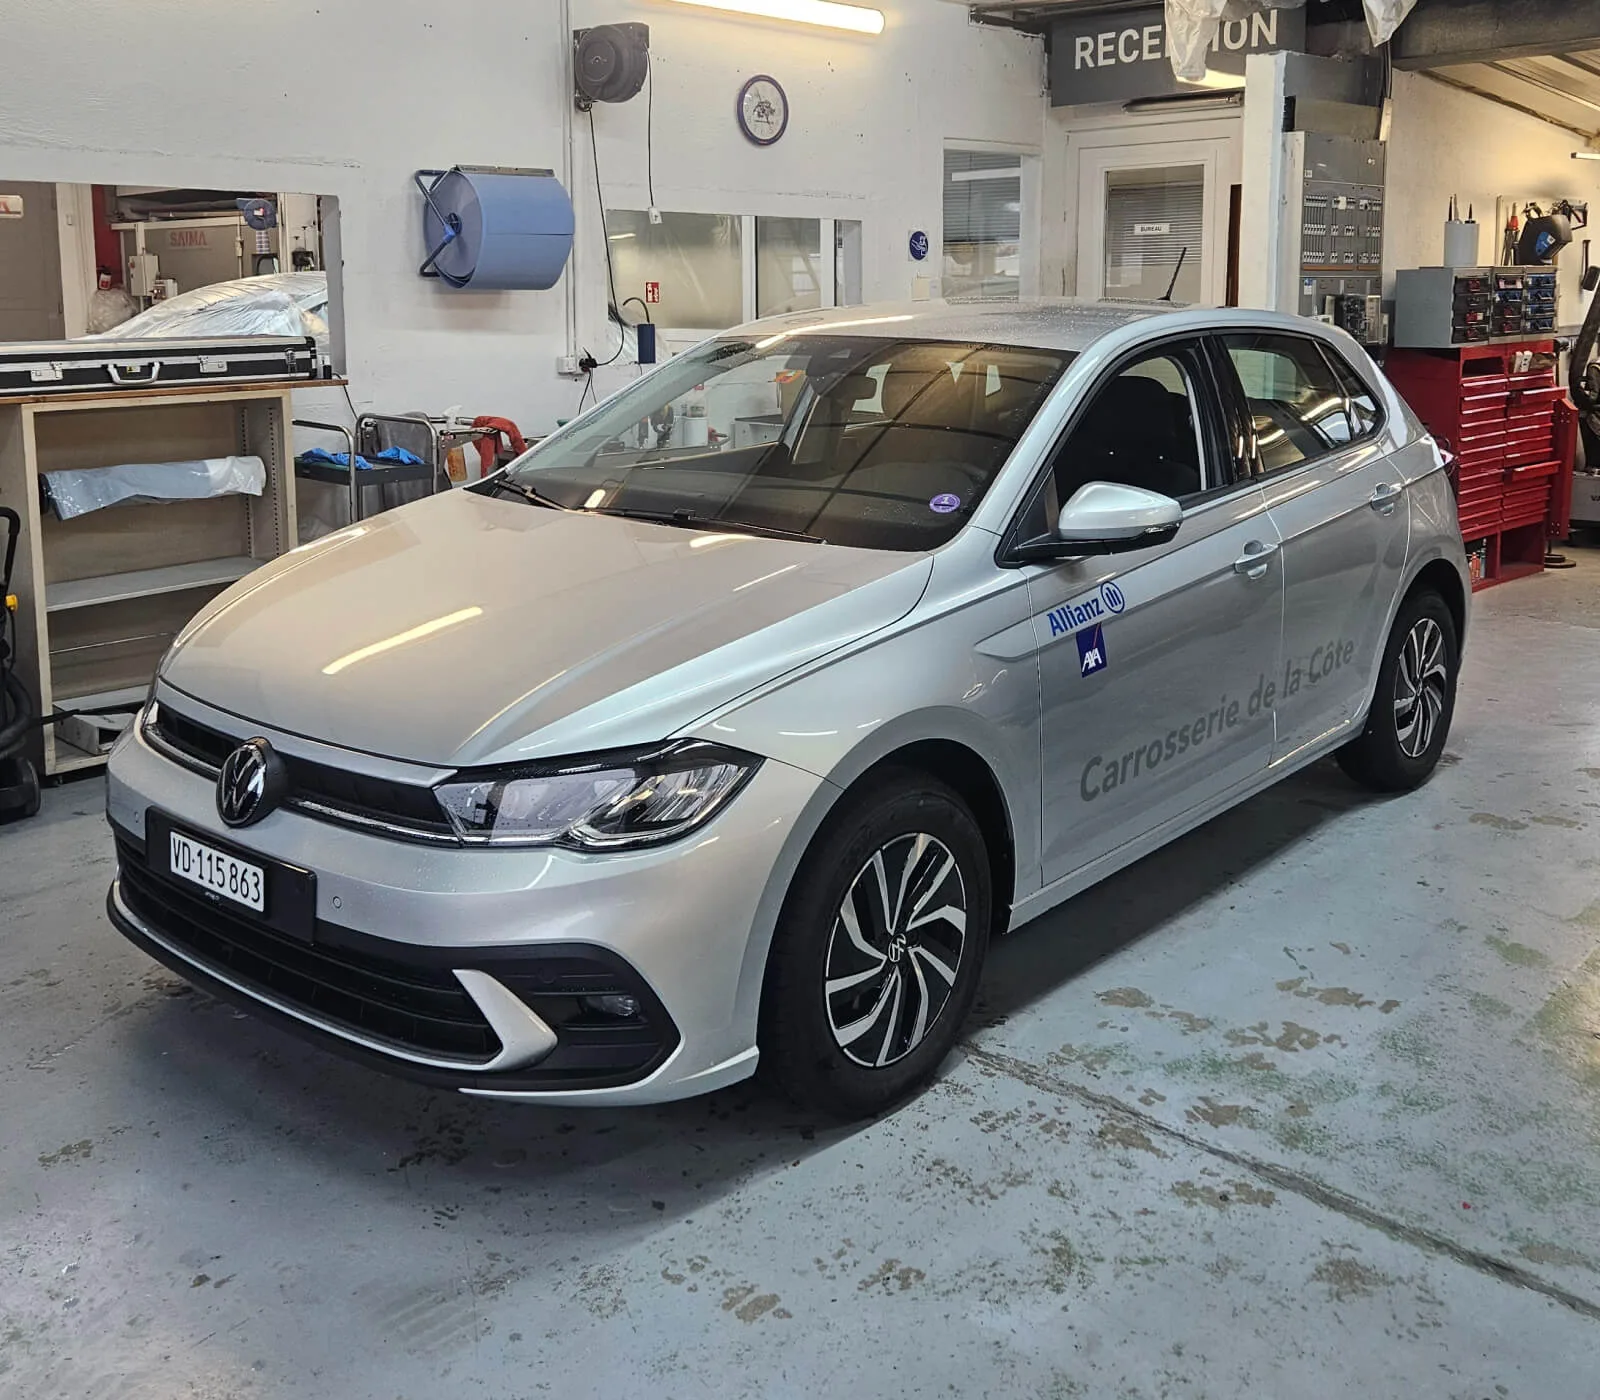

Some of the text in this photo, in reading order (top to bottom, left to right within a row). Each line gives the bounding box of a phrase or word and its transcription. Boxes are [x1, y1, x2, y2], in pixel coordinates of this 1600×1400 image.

[1074, 9, 1278, 70] RECEION
[169, 230, 208, 247] SAIMA
[1047, 597, 1104, 636] Allianz
[1081, 647, 1103, 673] AXA
[1080, 639, 1354, 802] Carrosserie de la Côte
